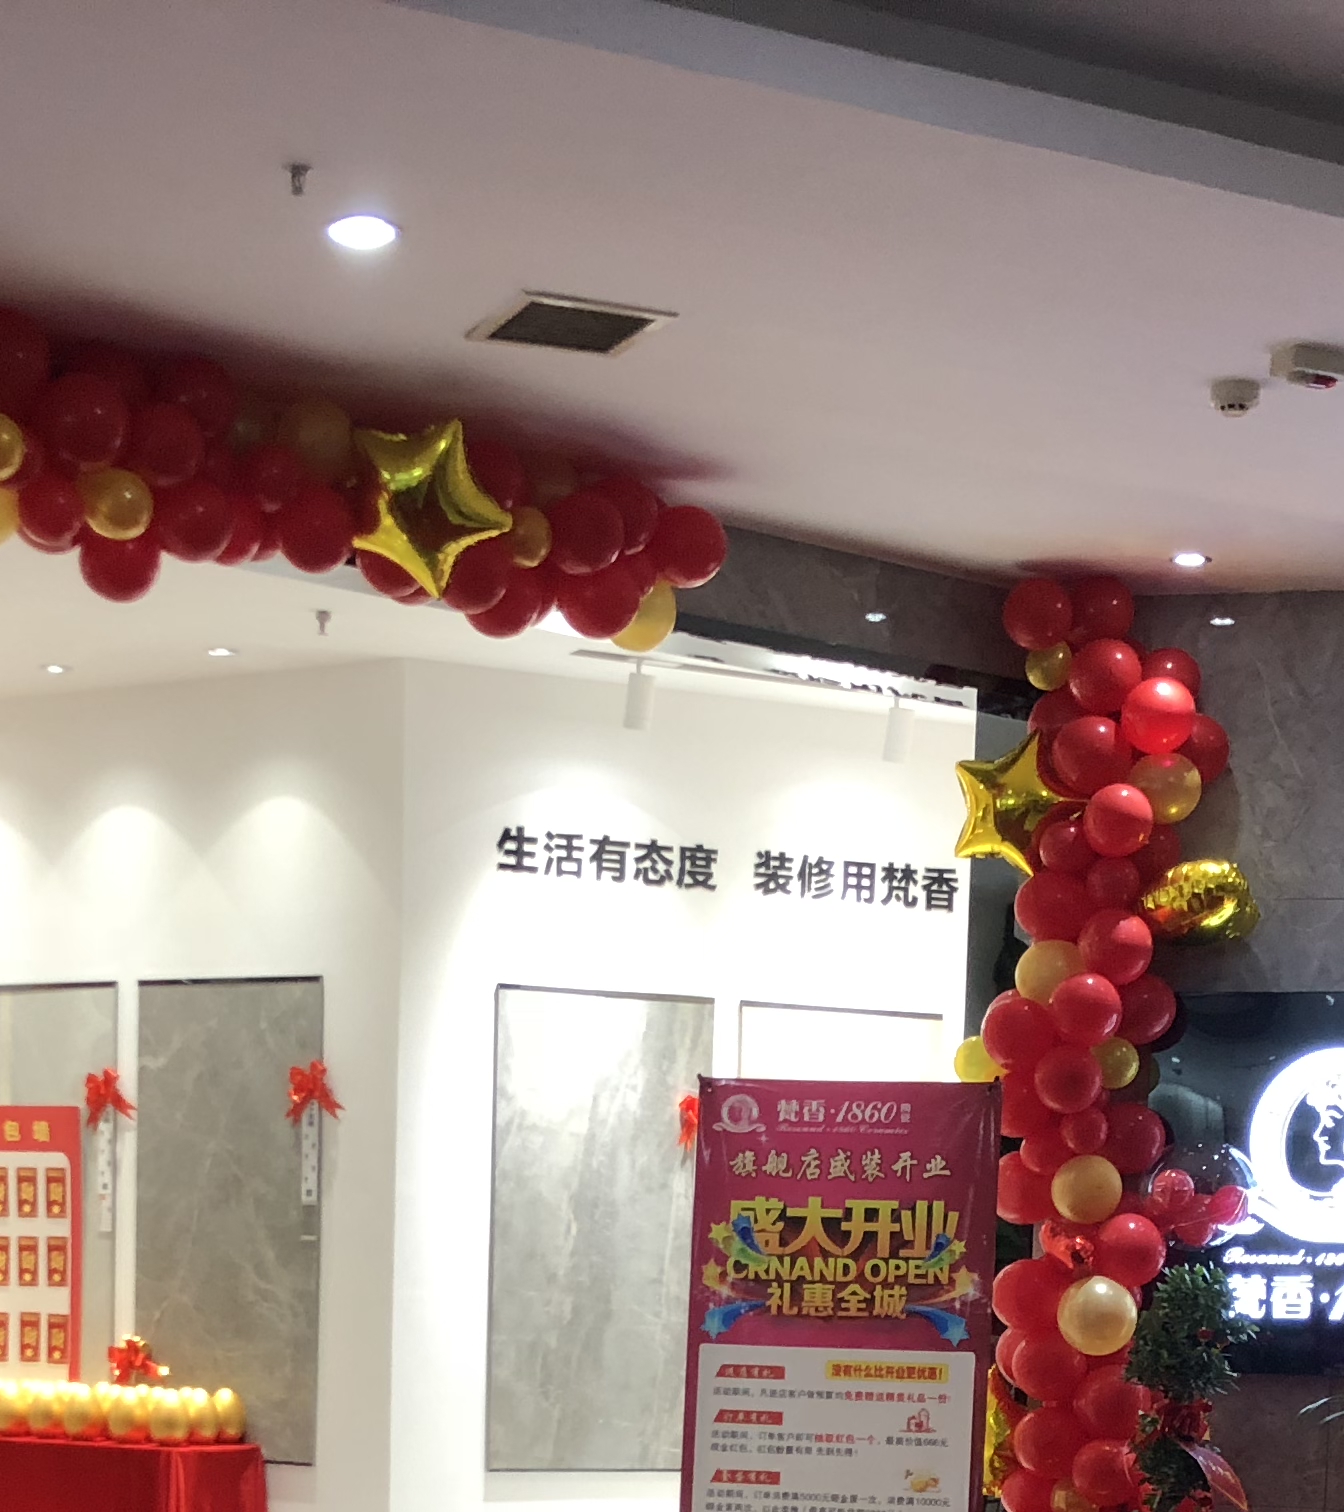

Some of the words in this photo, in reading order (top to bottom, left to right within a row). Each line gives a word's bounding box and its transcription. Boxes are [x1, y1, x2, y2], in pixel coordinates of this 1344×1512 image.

[496, 826, 718, 892] 生活有态度
[753, 849, 959, 913] 装修用梵香
[729, 1147, 952, 1182] 旗舰店盛装开业
[730, 1196, 960, 1258] 盛大开业
[864, 1259, 949, 1285] OPEN
[766, 1283, 907, 1319] 礼惠全城
